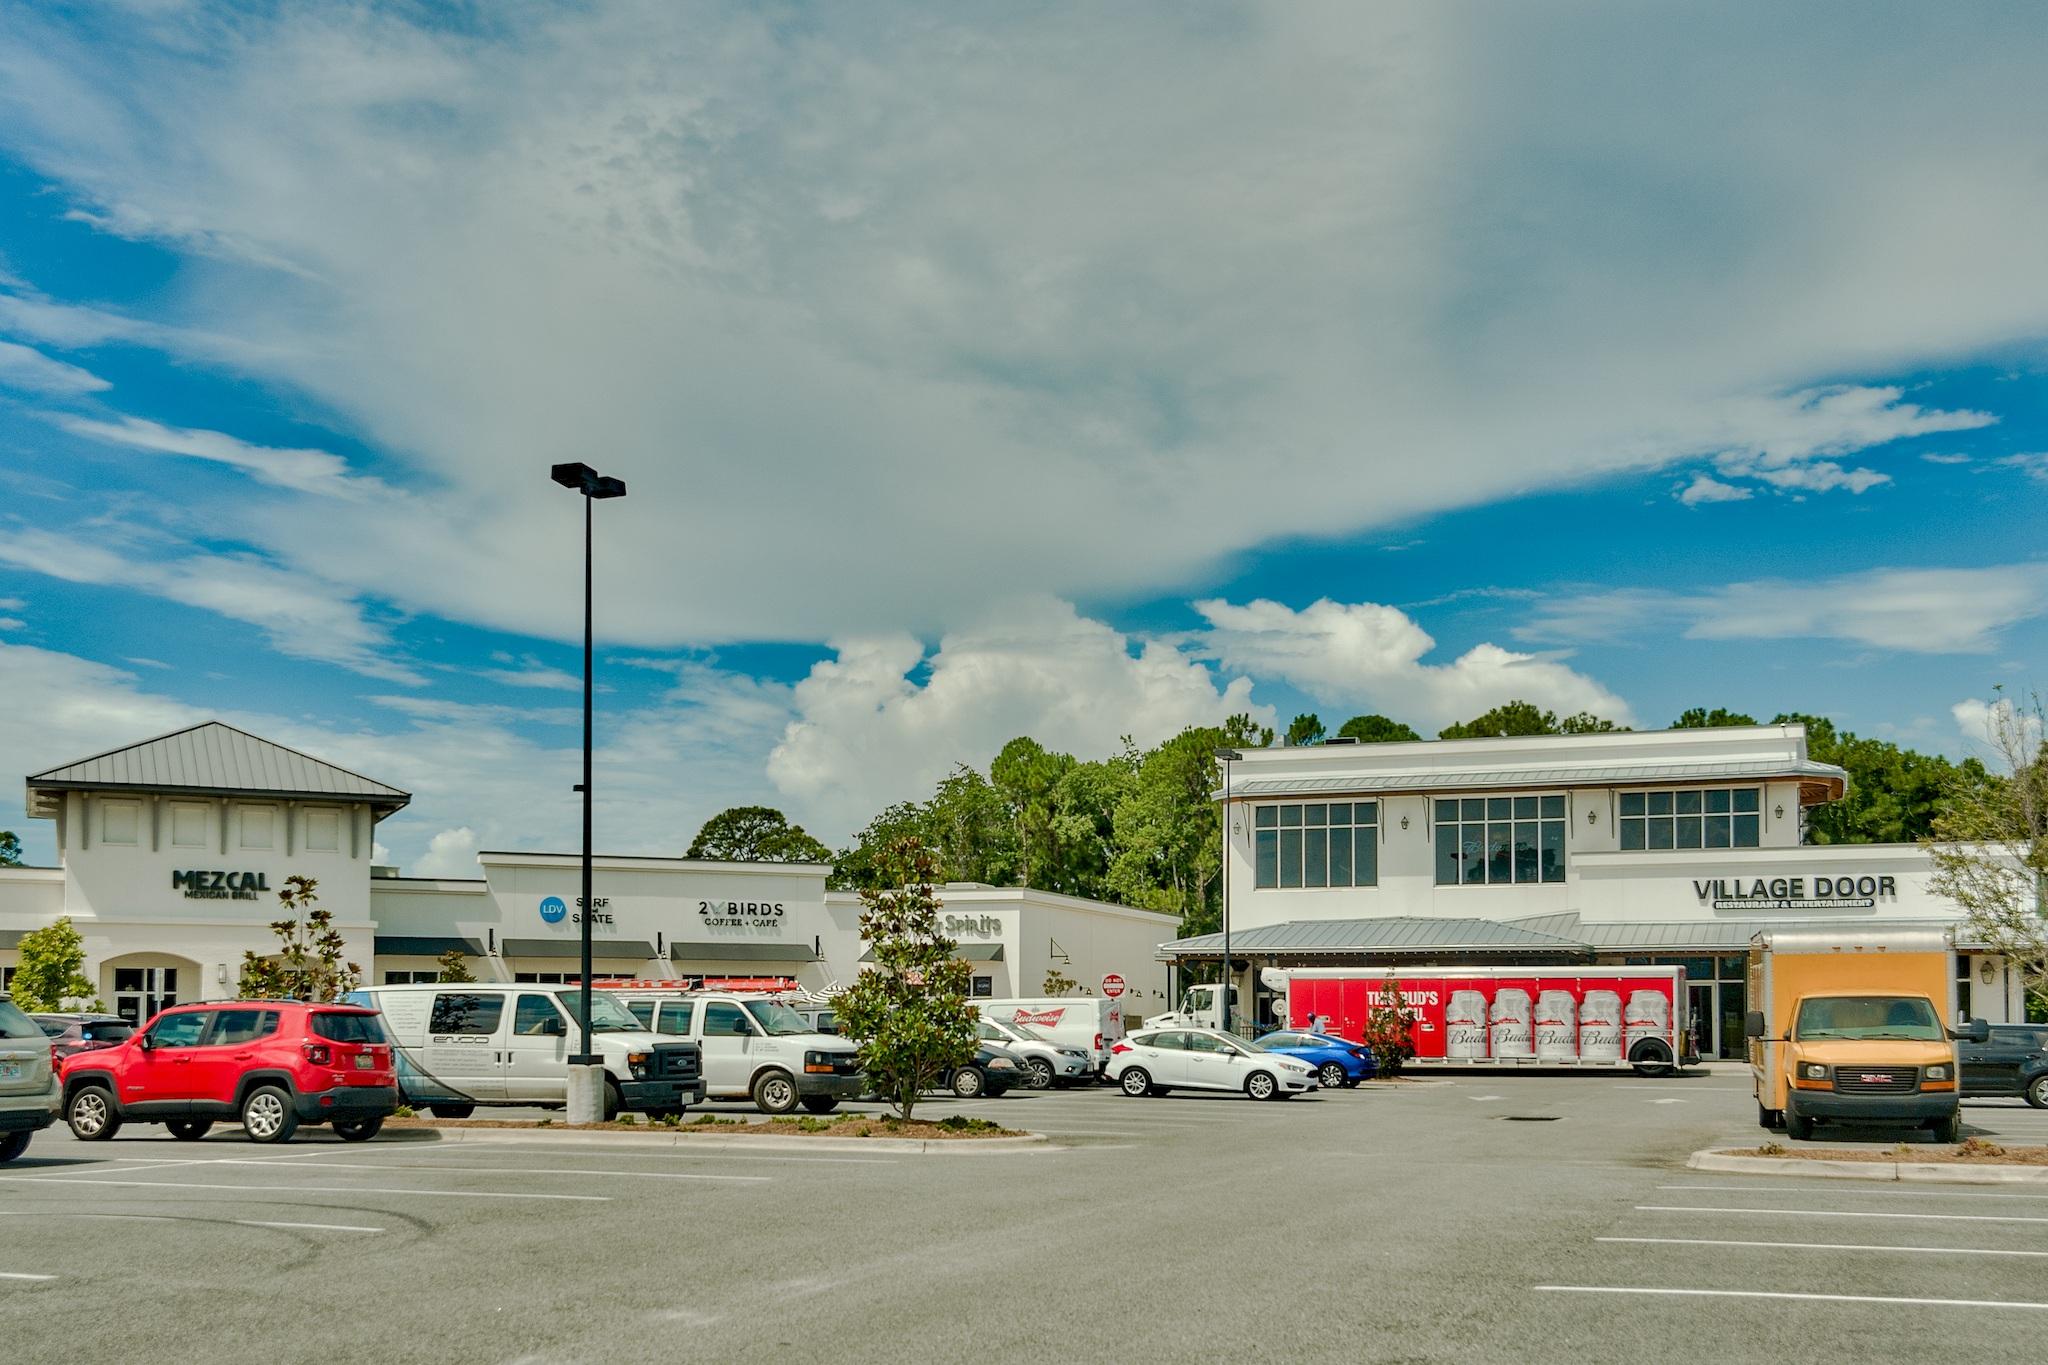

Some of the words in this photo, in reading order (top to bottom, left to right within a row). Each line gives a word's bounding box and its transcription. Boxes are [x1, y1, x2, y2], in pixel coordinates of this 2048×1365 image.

[172, 870, 271, 891] MEZCAL
[1692, 878, 1804, 900] VILLAGE
[1814, 876, 1896, 898] DOOR
[184, 890, 229, 900] MEXICAN
[231, 891, 259, 901] GRILL
[576, 897, 609, 908] SRF
[1715, 901, 1779, 909] RESTAURANT
[1780, 901, 1789, 909] &
[1790, 899, 1872, 908] ENTERTAINMENT
[543, 905, 564, 914] LDV
[698, 901, 708, 915] 2
[727, 902, 784, 917] BIRDS
[572, 914, 613, 924] SATE
[704, 918, 743, 926] COFFEE
